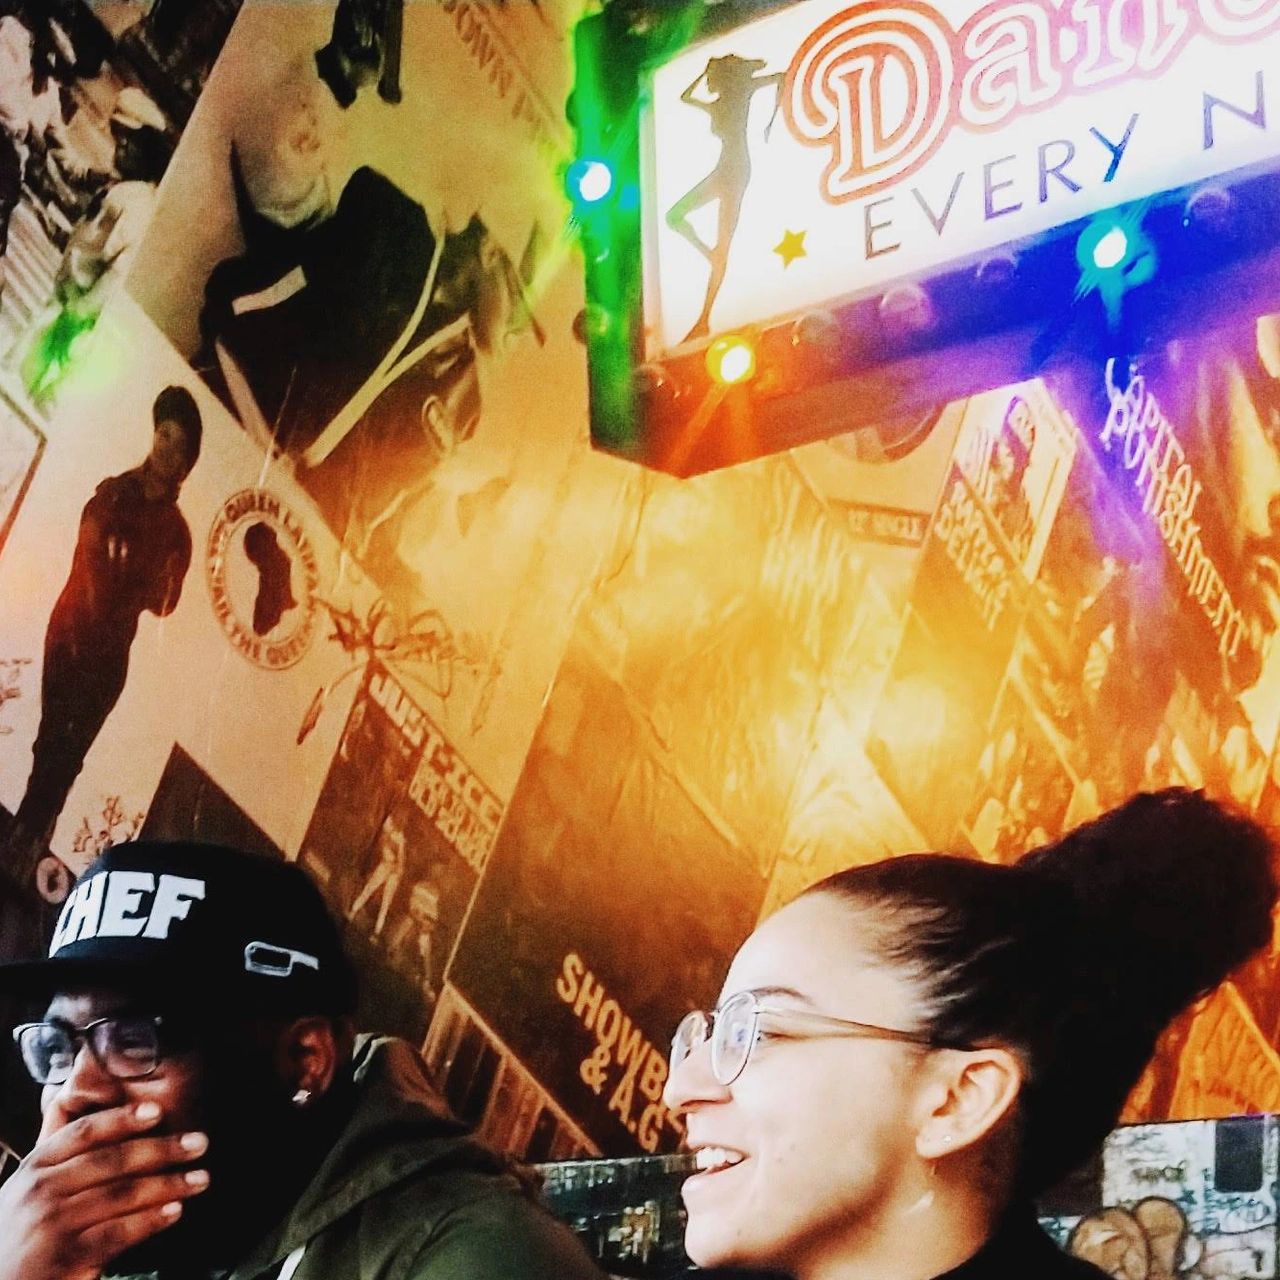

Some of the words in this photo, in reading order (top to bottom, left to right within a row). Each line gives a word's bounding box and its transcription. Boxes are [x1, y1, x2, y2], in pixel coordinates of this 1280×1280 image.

[863, 112, 1139, 261] EVERY
[557, 952, 677, 1118] SHOWB
[580, 1050, 611, 1095] &
